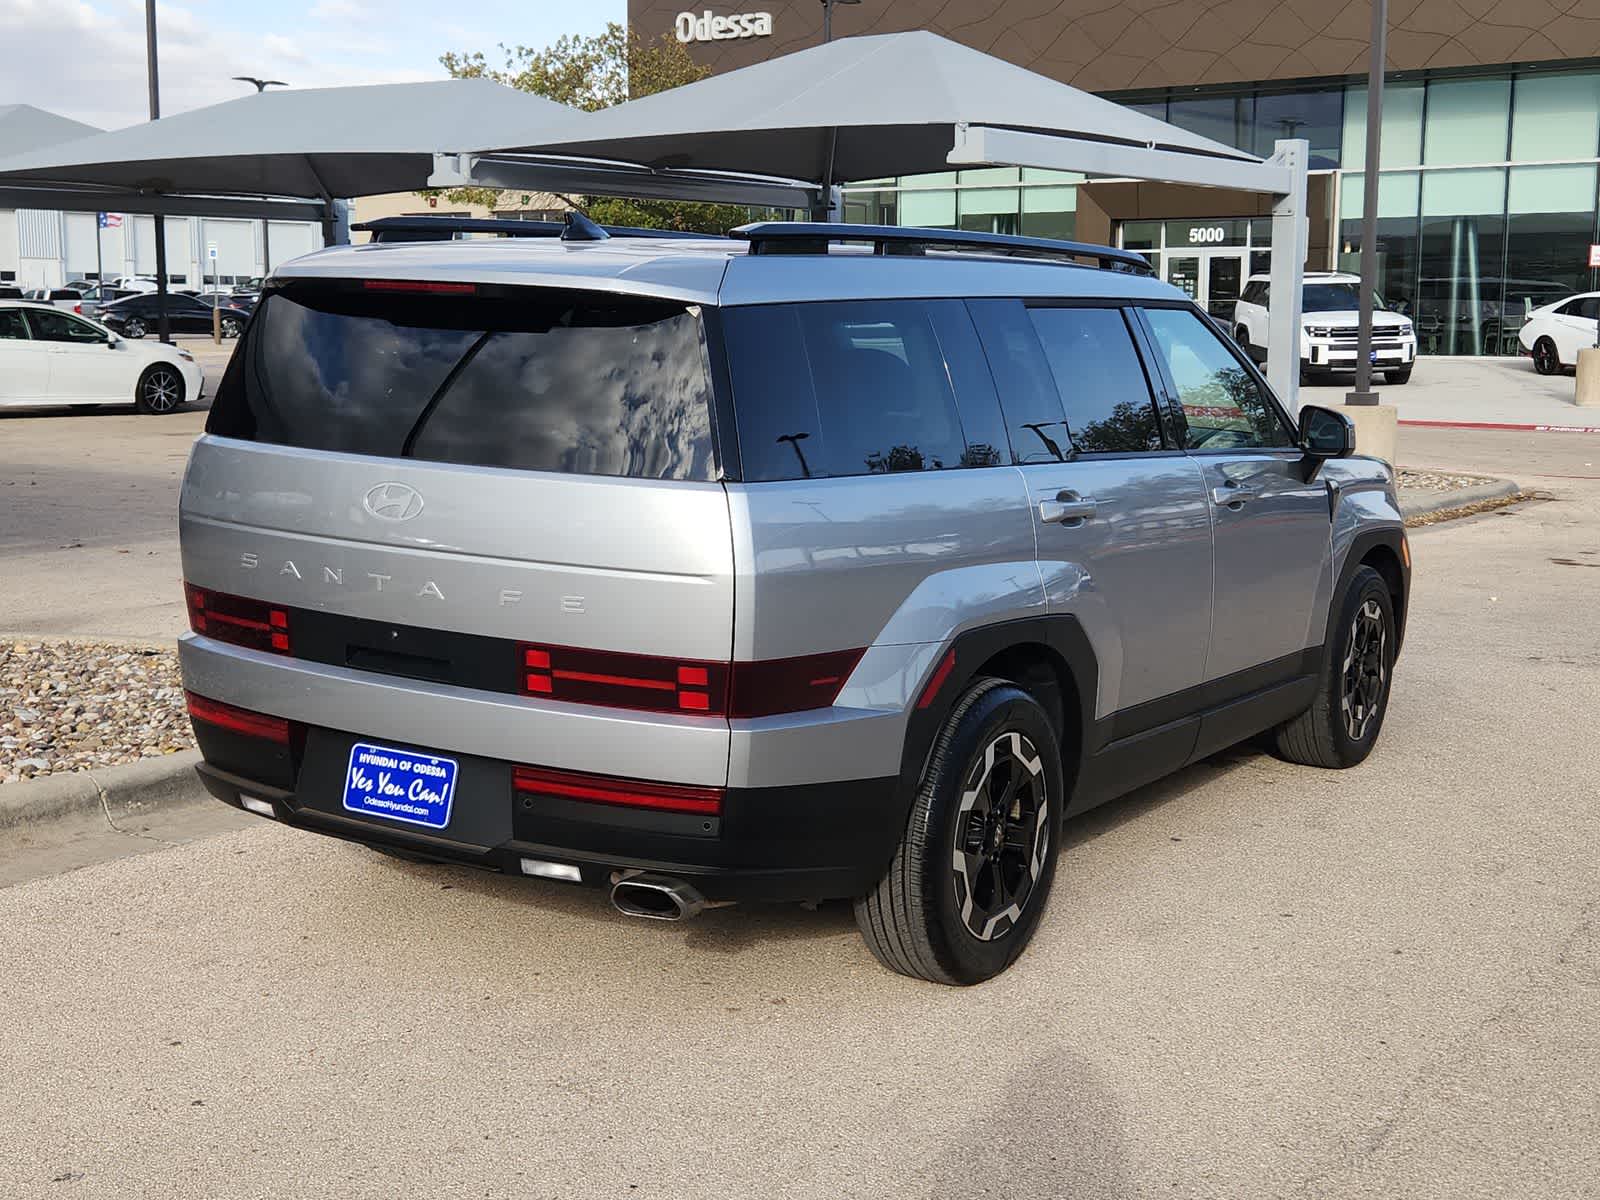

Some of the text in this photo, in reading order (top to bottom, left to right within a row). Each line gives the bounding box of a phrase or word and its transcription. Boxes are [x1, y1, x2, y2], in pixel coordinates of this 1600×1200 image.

[675, 10, 772, 42] Odessa
[1189, 227, 1224, 242] 5000
[239, 552, 585, 614] SANTA FE
[359, 753, 446, 778] HYUNDAI OF ODESSA
[351, 767, 449, 805] Yes You Can!
[363, 796, 429, 815] OdessaHyundai.com
